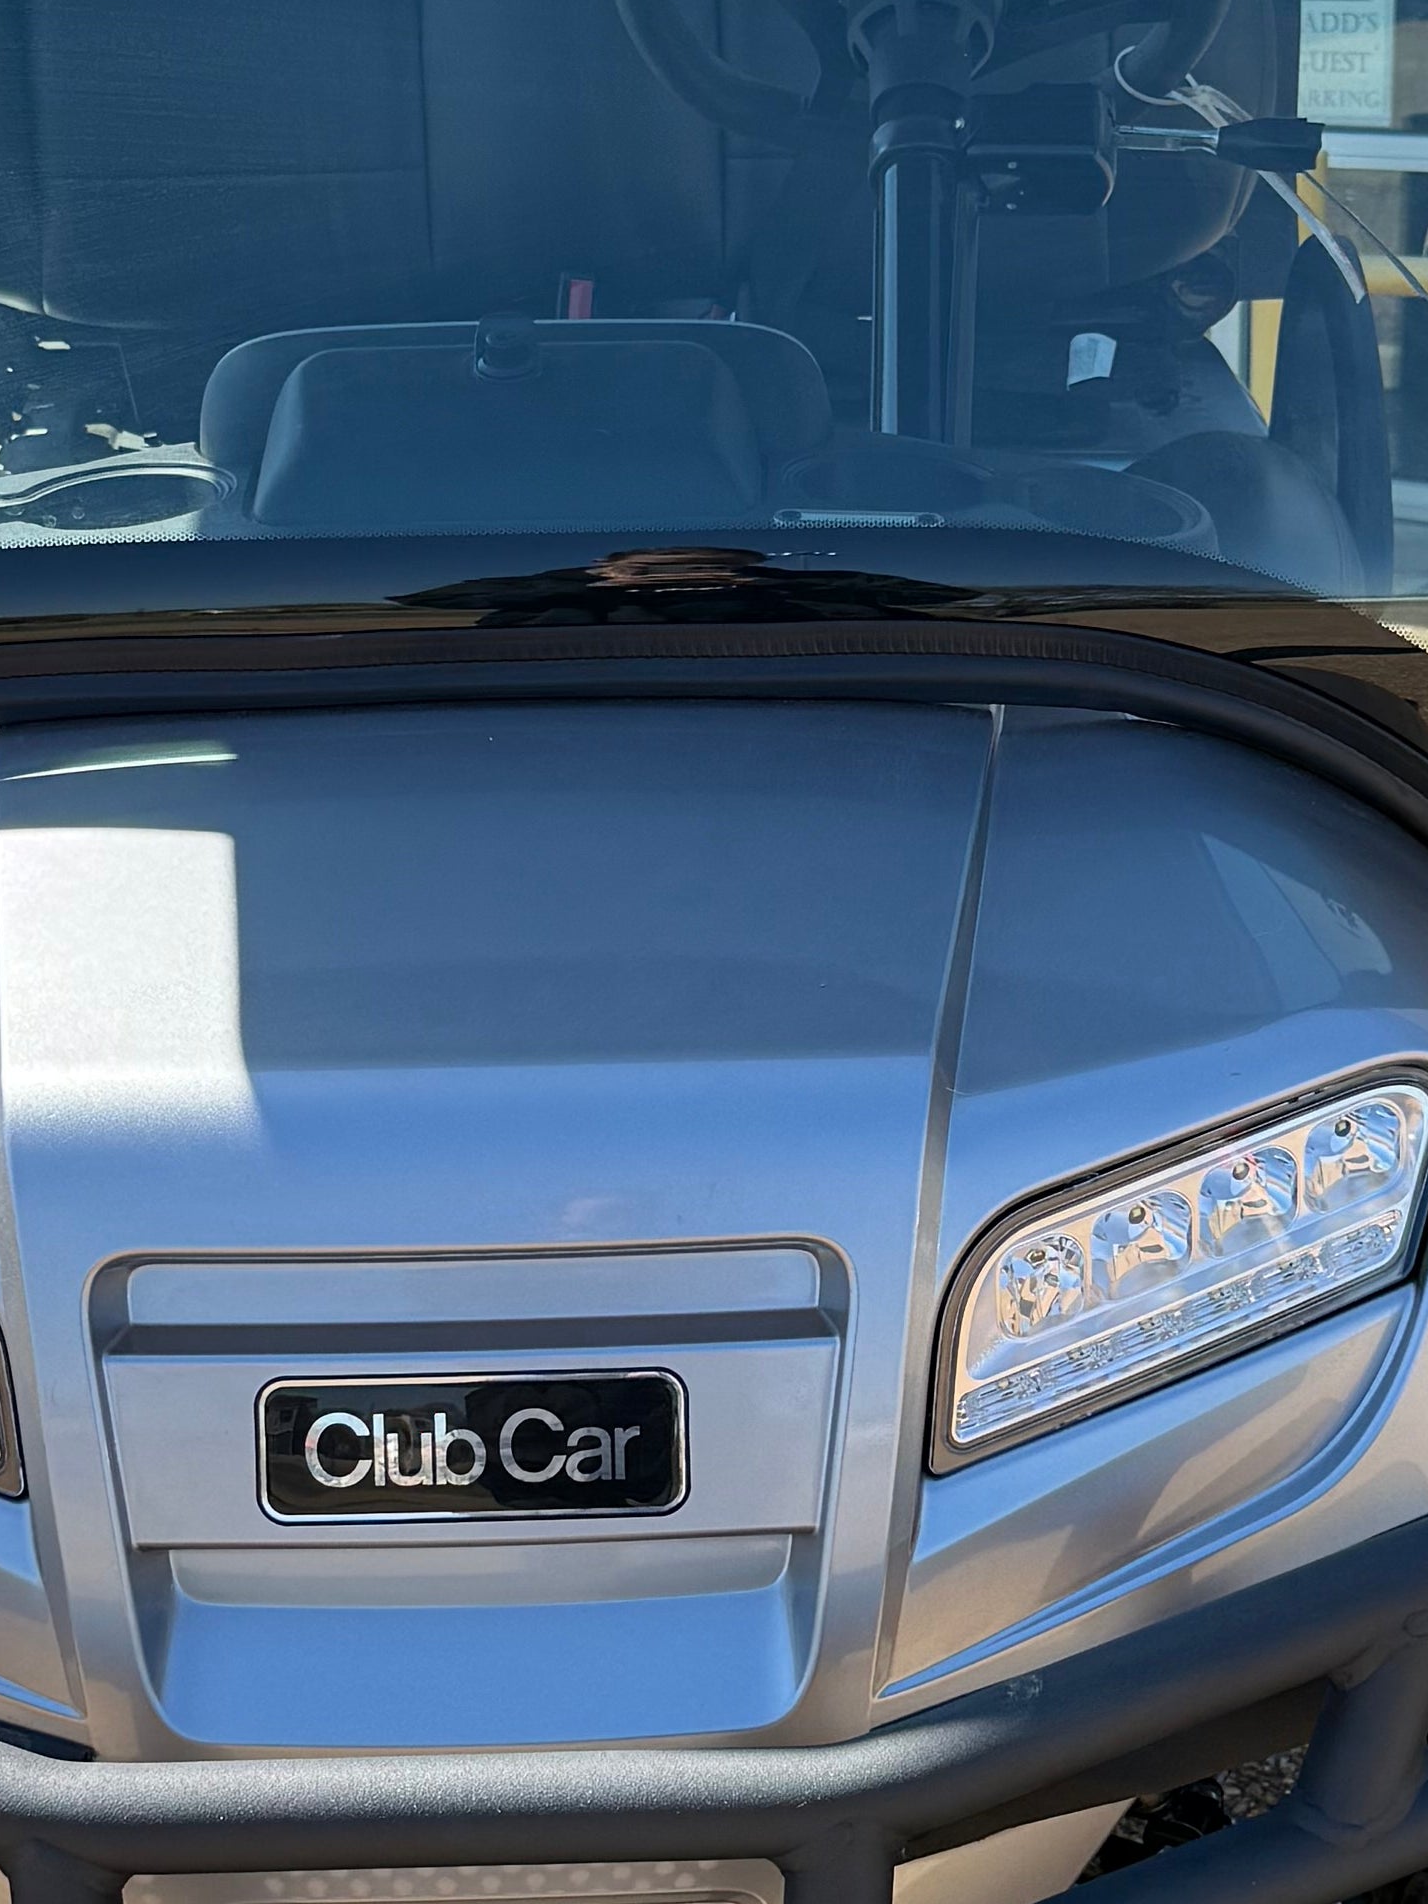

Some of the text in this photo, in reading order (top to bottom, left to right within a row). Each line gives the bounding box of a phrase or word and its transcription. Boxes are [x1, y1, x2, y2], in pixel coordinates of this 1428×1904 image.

[1300, 12, 1380, 34] ADD'S
[1302, 50, 1371, 73] UEST
[1303, 89, 1381, 109] RKING
[304, 1407, 641, 1488] Club Car
